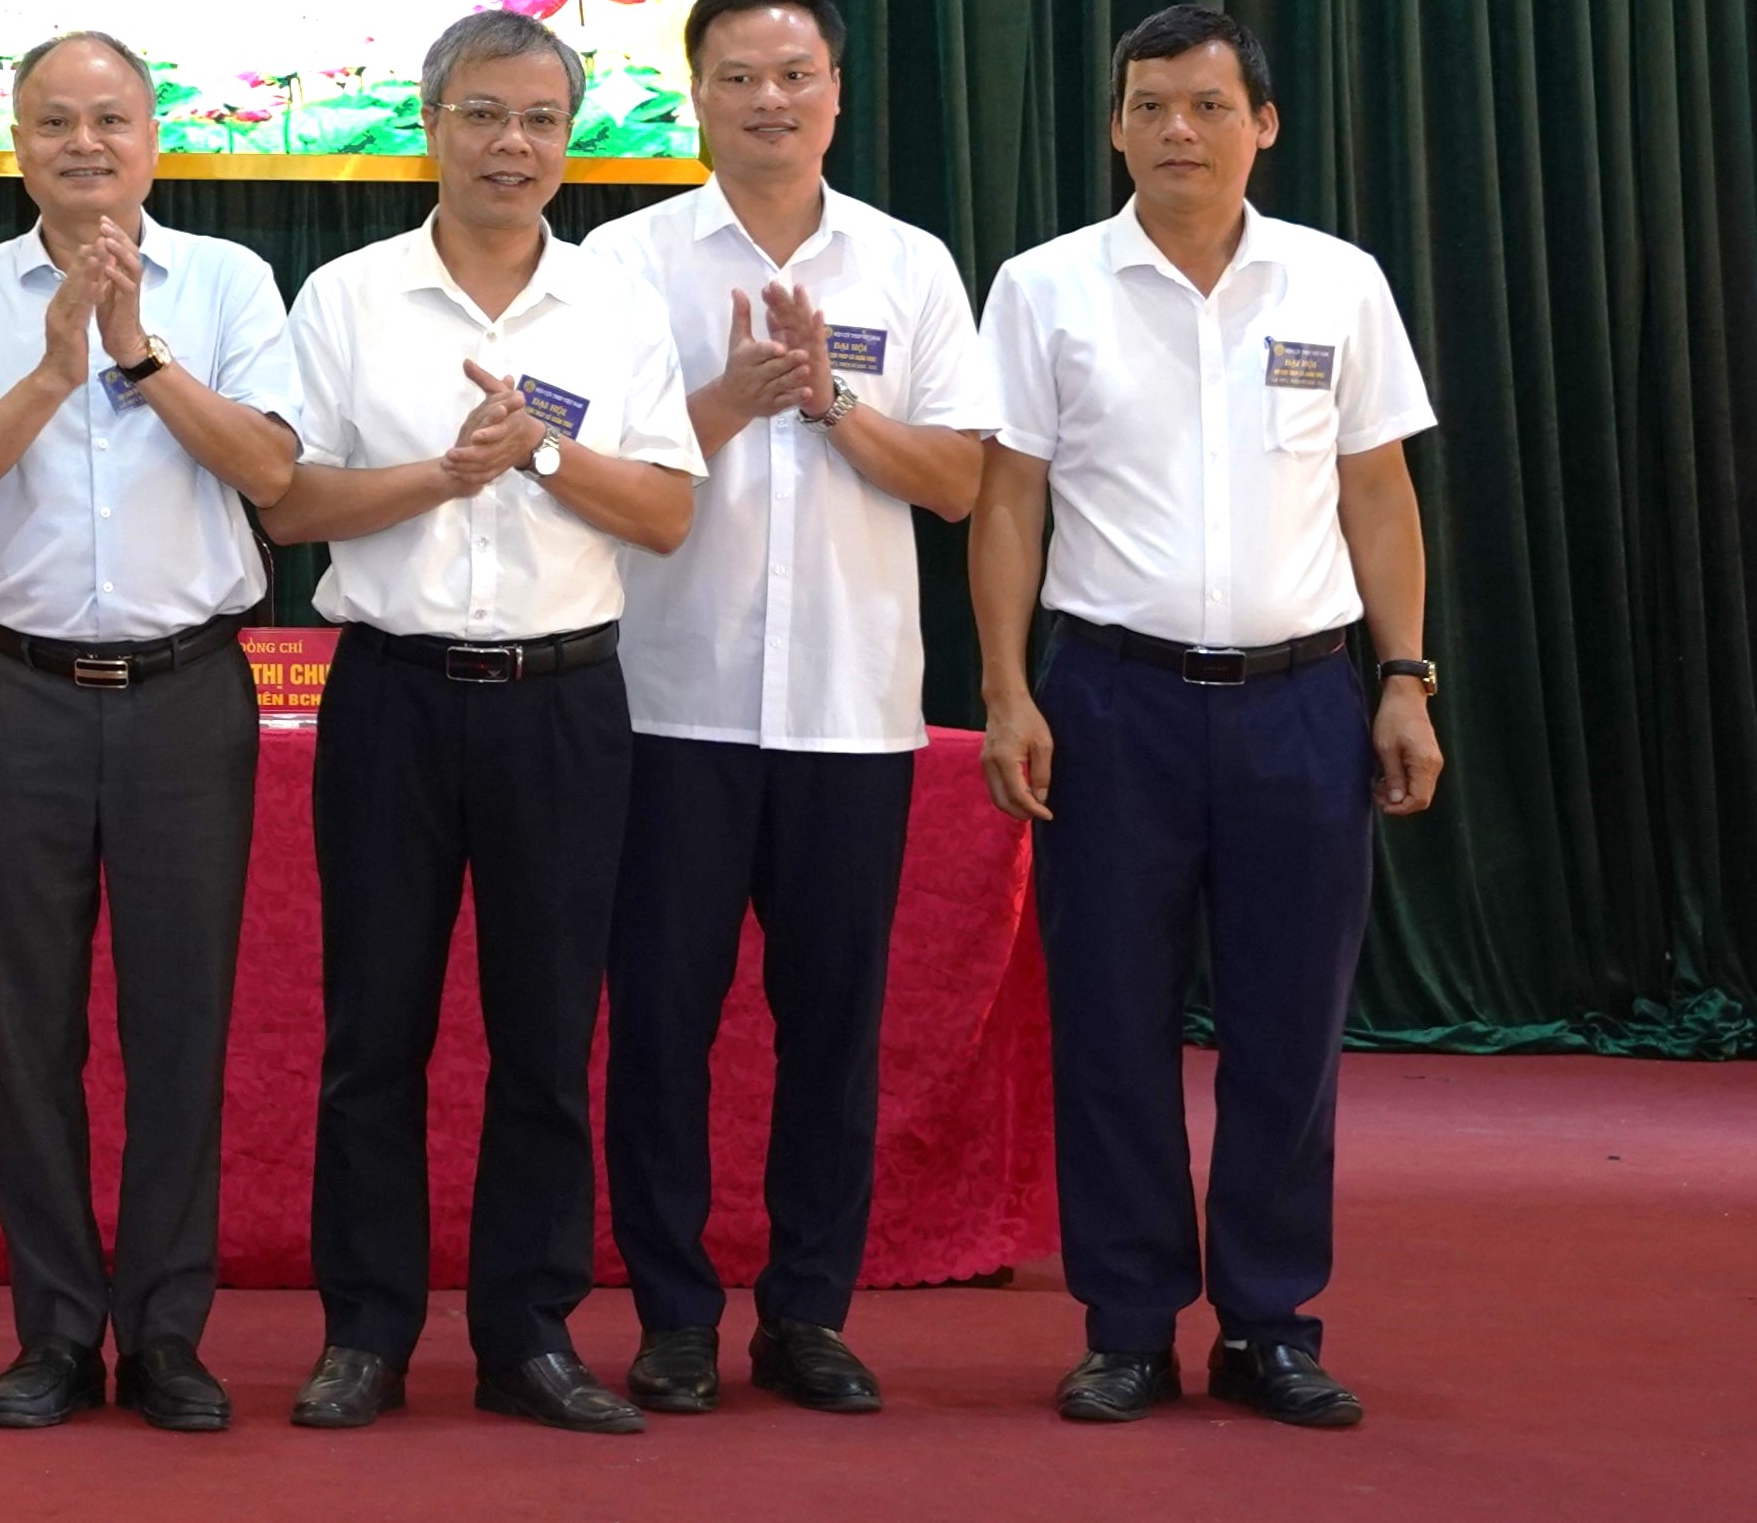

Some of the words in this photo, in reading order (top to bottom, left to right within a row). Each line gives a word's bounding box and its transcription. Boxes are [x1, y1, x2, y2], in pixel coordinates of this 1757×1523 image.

[279, 640, 303, 653] CHÍ
[251, 664, 283, 689] THỊ
[288, 693, 321, 706] BCH
